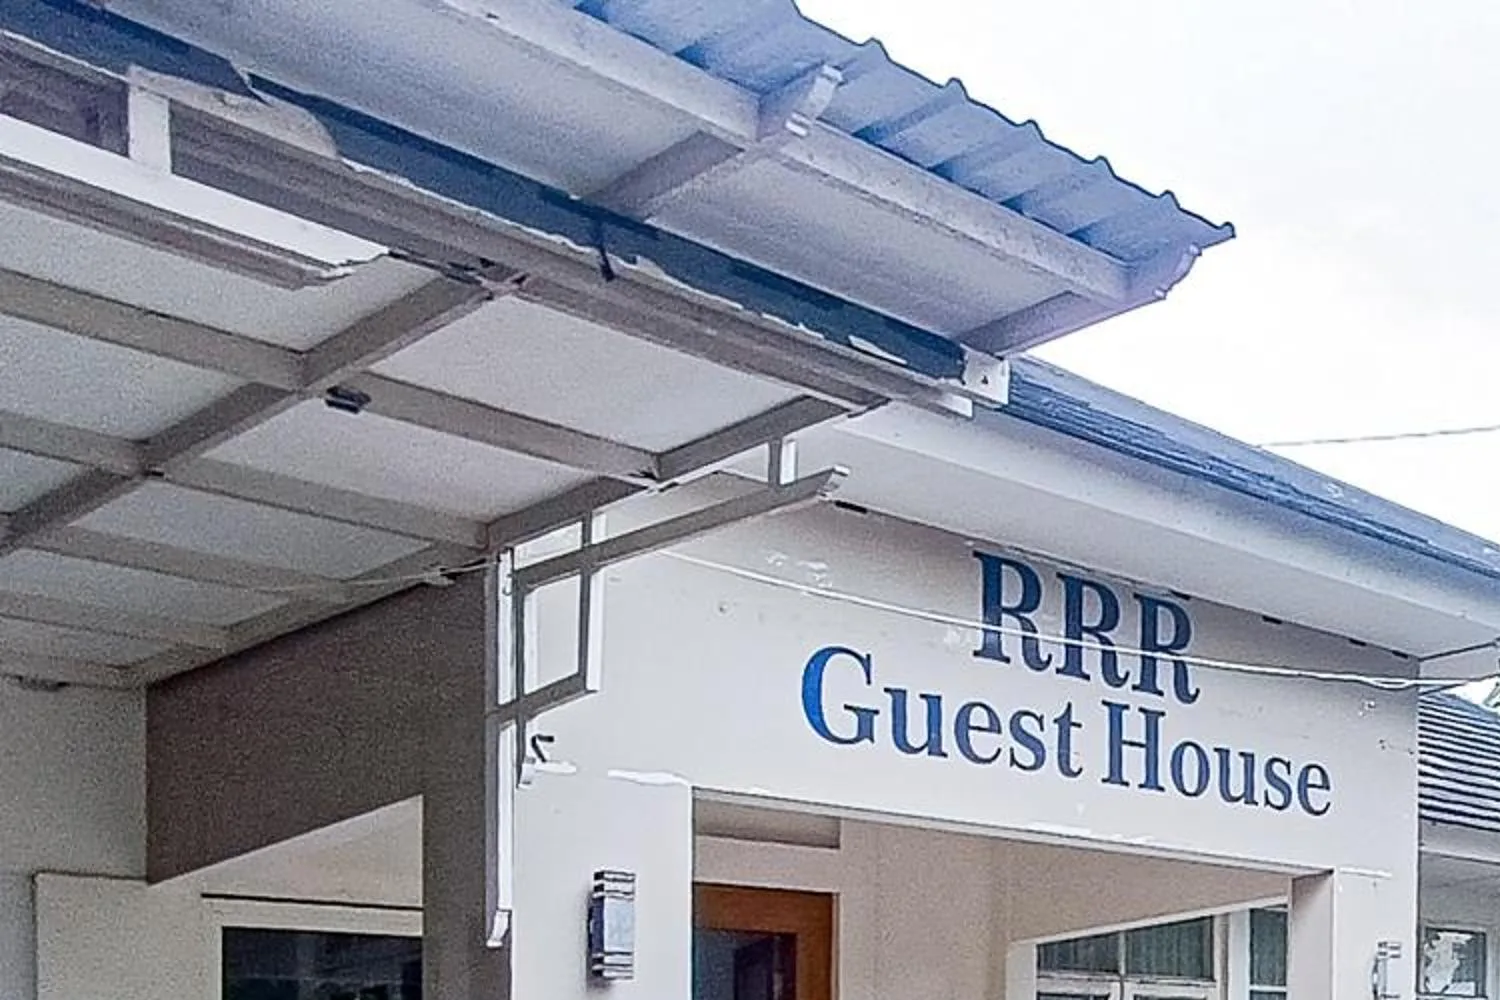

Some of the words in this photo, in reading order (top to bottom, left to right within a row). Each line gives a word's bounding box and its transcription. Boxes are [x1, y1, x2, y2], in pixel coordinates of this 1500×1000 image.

[973, 550, 1199, 704] RRR
[801, 646, 1083, 778] Guest
[1101, 700, 1332, 815] House
